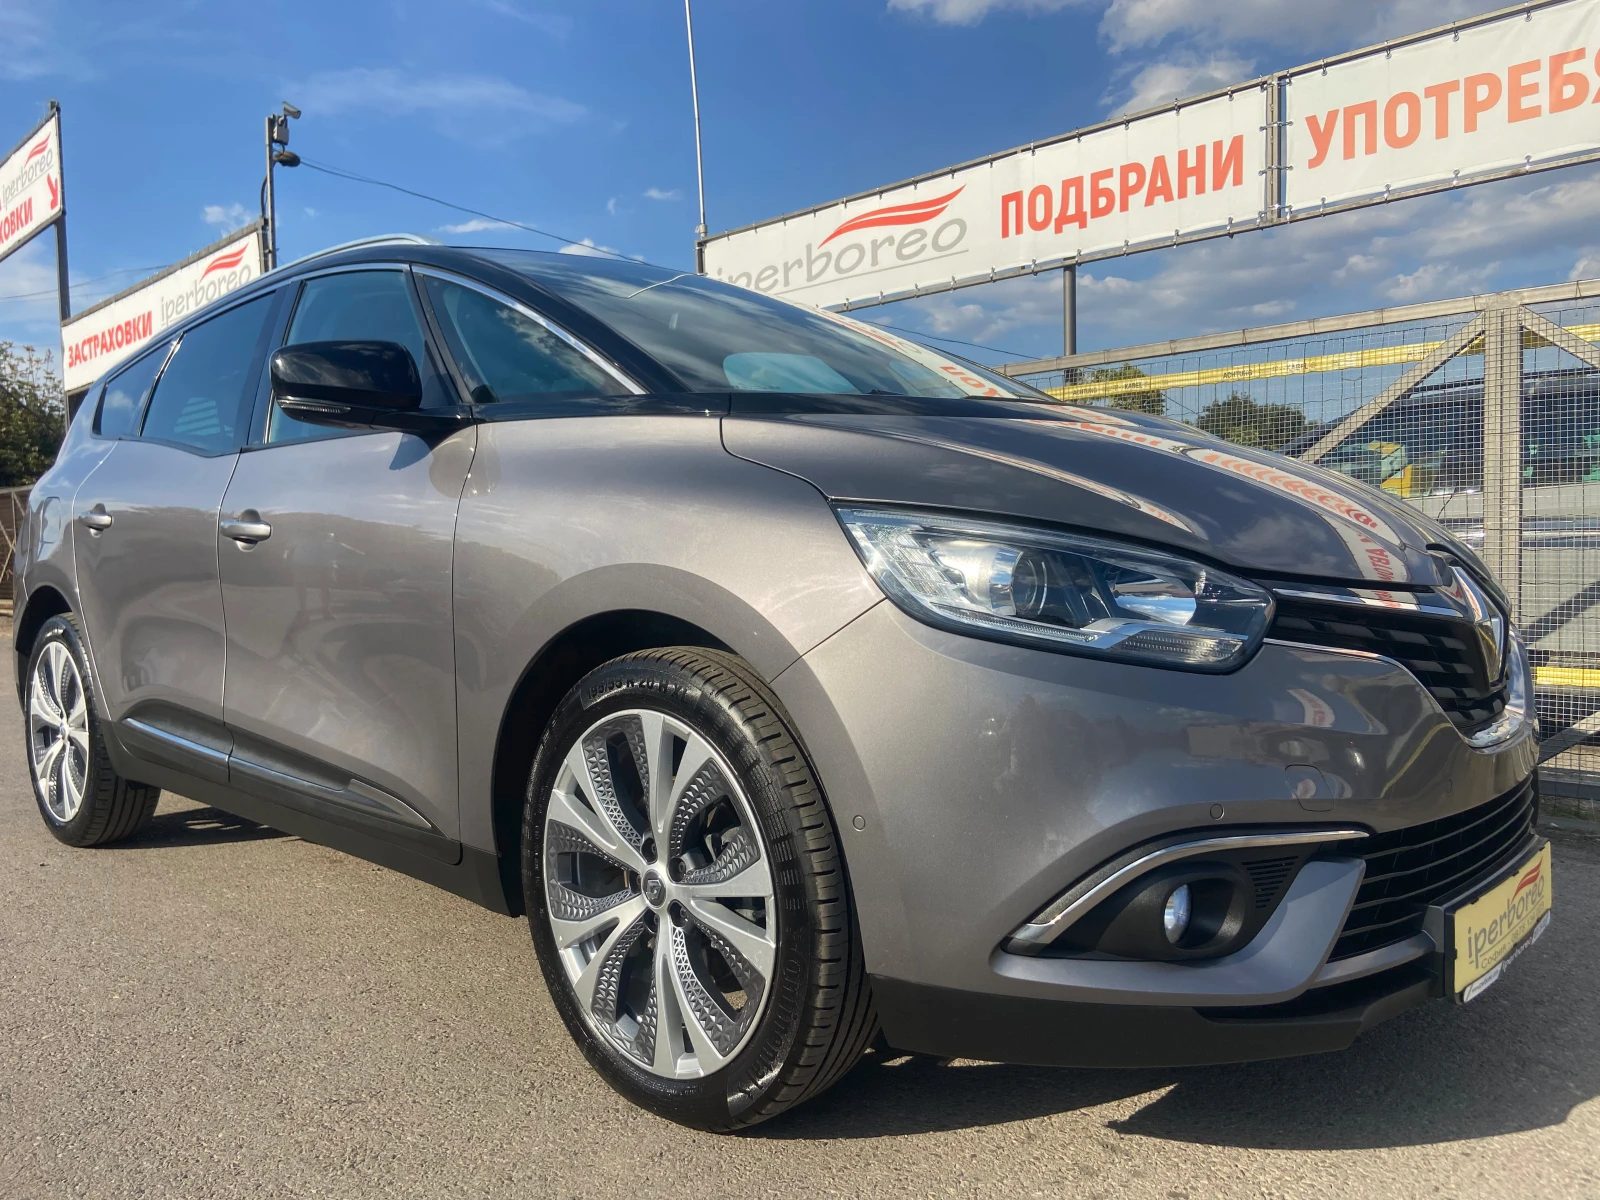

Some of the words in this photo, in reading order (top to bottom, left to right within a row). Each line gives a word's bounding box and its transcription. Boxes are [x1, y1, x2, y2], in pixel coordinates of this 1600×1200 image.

[1305, 46, 1600, 169] УПОТРЕБ
[3, 148, 53, 211] iperboreo
[1001, 134, 1244, 239] ПОДБРАНИ
[161, 264, 251, 327] iperboreo
[68, 310, 152, 368] ЗАСТРАХОВКИ
[1073, 387, 1098, 396] ACHTUNG
[1124, 381, 1143, 390] KABEL
[1223, 370, 1253, 379] ACHTUNG
[1287, 363, 1308, 372] KABEL
[639, 679, 655, 690] 20
[1468, 875, 1545, 969] iperboreo
